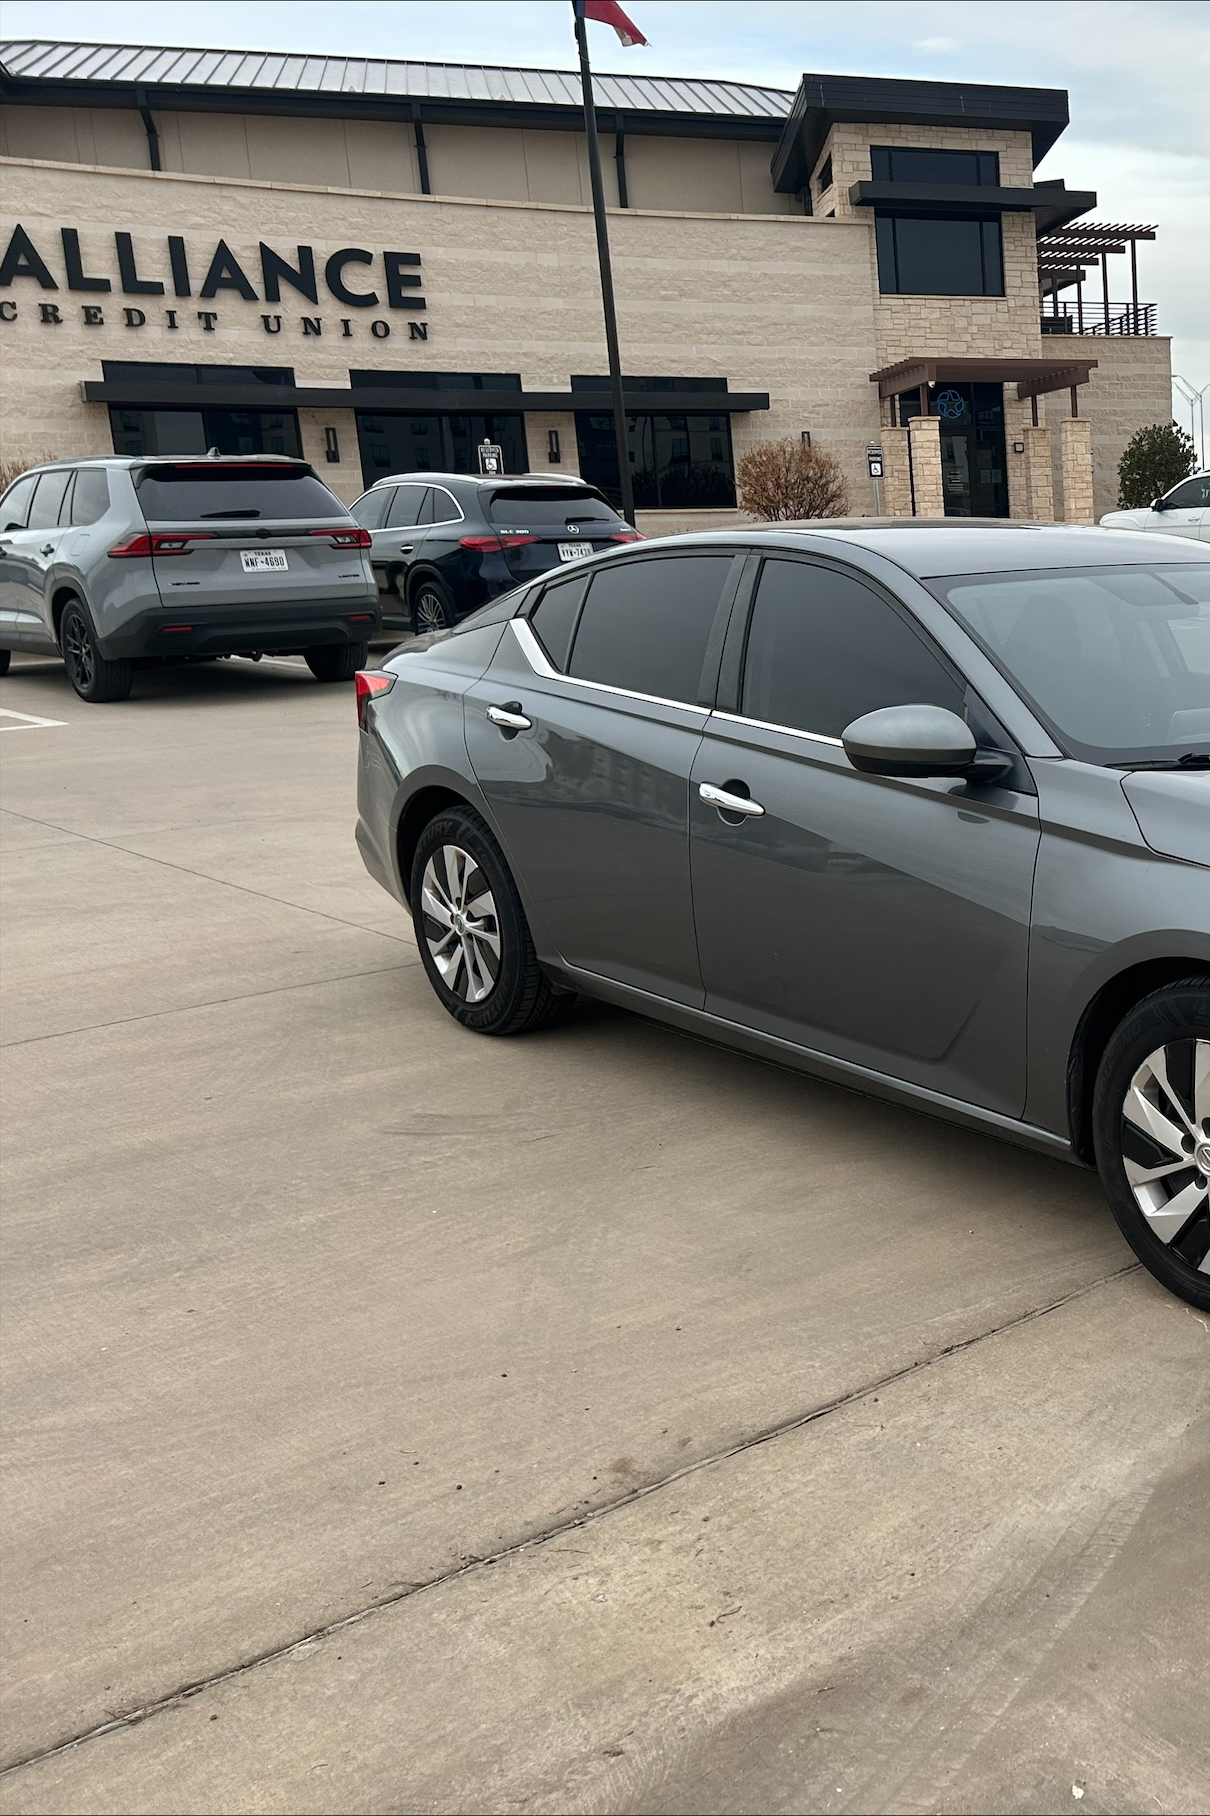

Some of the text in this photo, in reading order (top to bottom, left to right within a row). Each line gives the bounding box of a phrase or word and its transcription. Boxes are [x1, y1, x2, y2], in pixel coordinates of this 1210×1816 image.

[0, 223, 427, 310] ALLIANCE
[0, 300, 429, 341] CREDIT UNION
